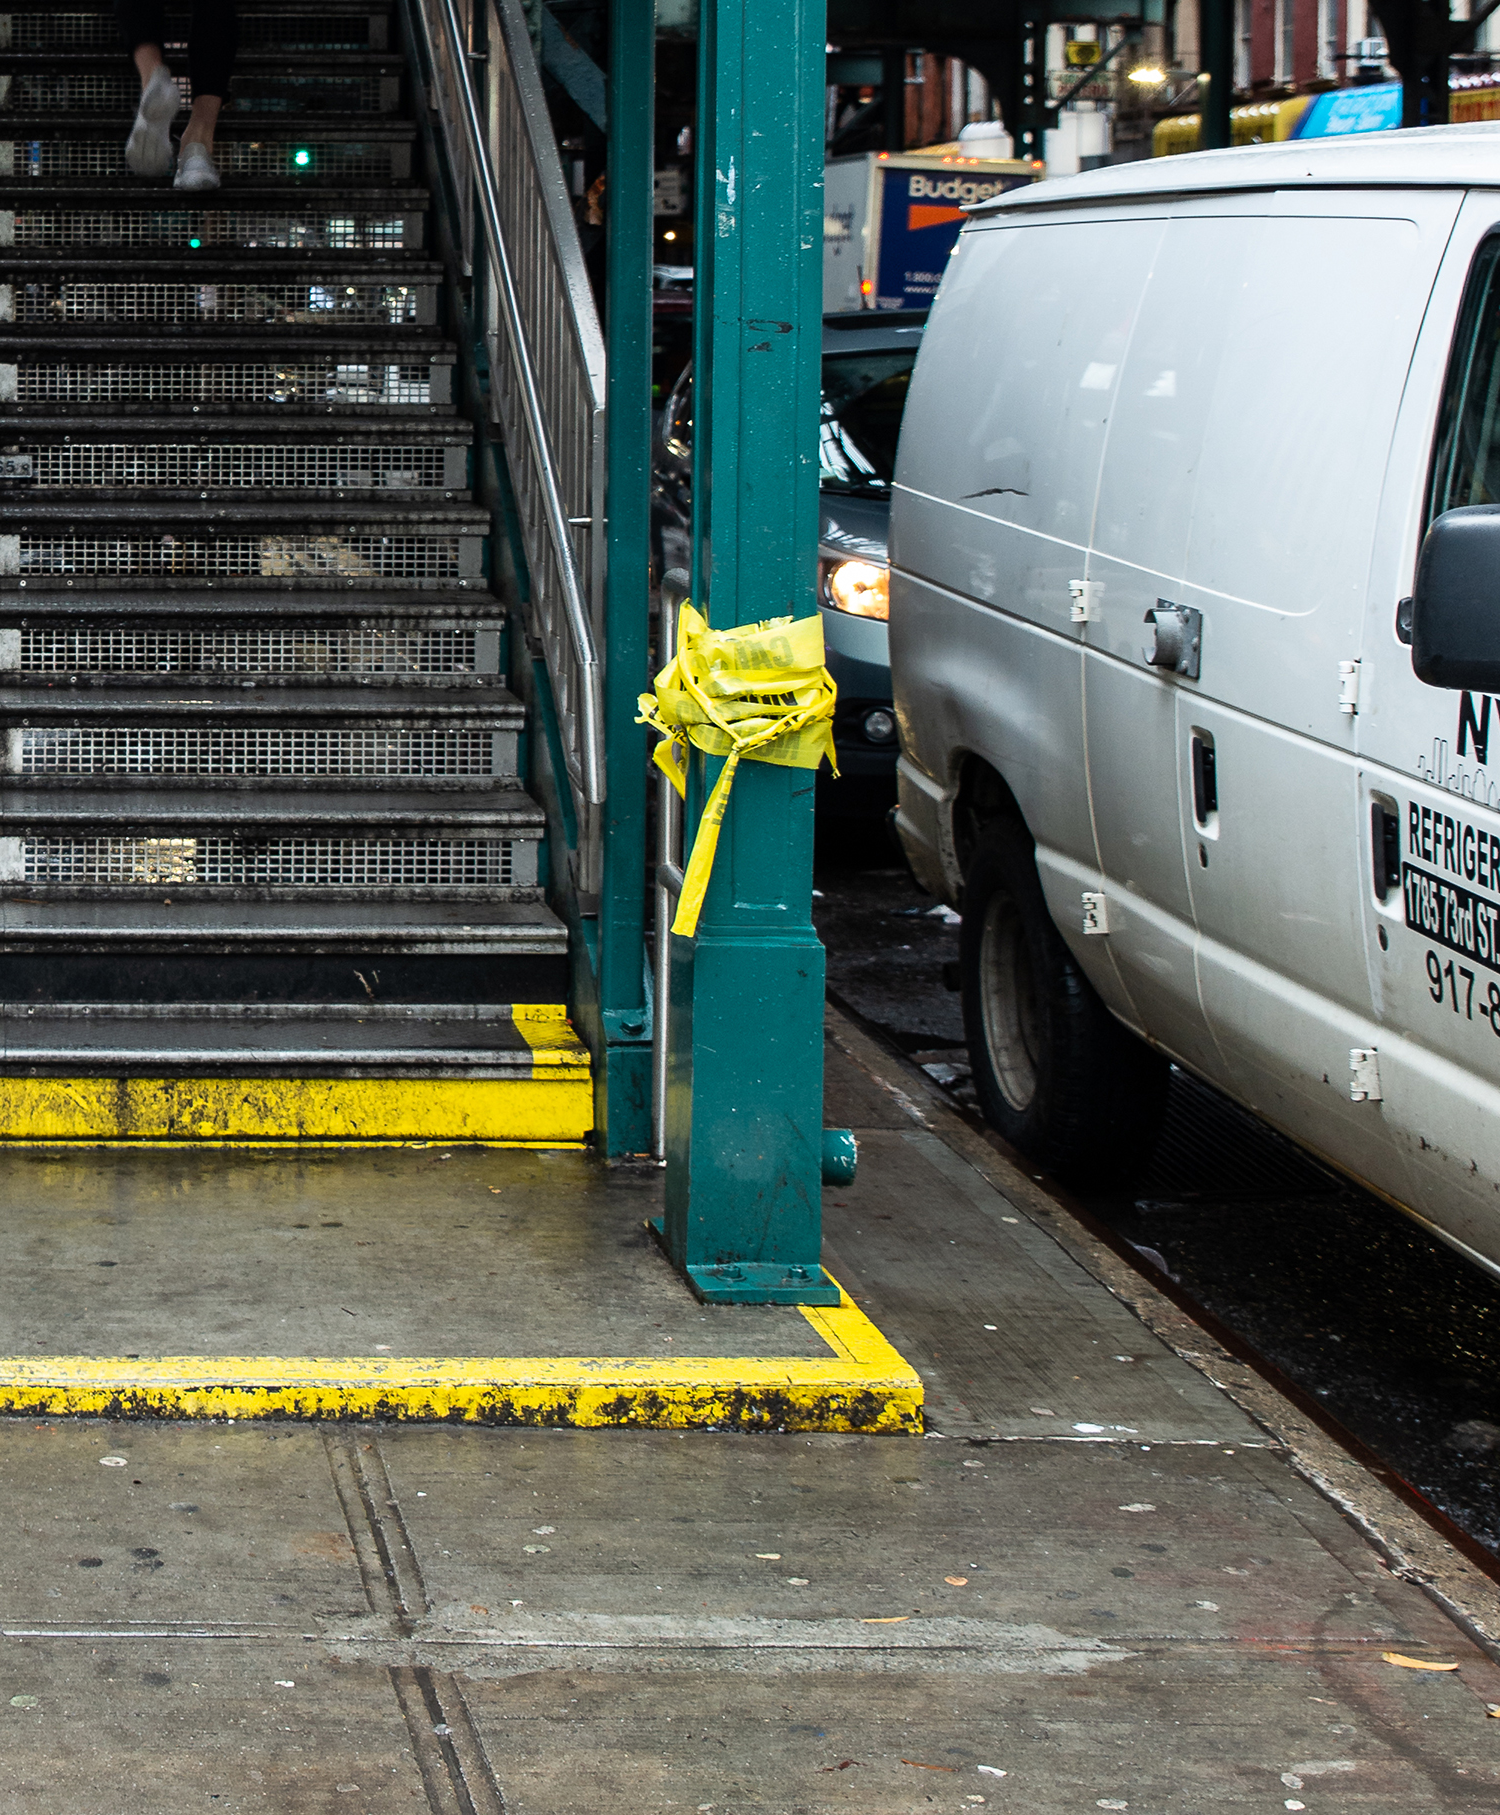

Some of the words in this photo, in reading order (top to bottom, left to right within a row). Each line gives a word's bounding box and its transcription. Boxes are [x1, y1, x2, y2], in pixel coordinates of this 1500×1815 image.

[908, 175, 1005, 204] Budget
[1405, 869, 1440, 934] 1785
[1441, 883, 1474, 948] 73rd
